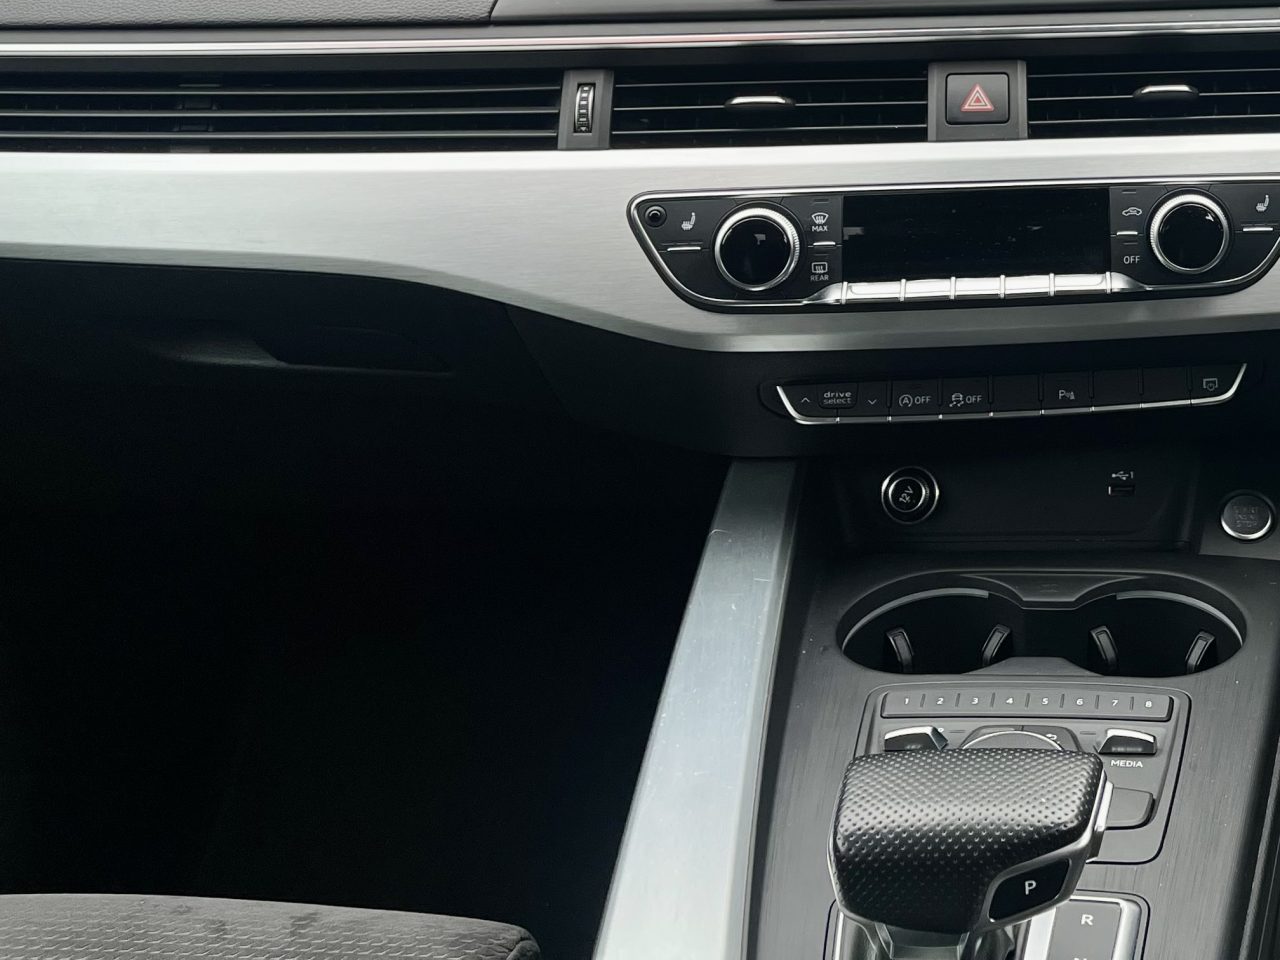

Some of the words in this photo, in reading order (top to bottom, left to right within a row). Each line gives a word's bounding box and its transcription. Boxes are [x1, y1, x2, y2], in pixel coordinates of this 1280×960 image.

[1123, 255, 1141, 264] OFF
[810, 274, 829, 282] REAR
[823, 397, 852, 405] select
[914, 395, 931, 404] OFF
[965, 394, 982, 404] OFF
[899, 485, 914, 503] 12V
[904, 697, 909, 705] 1
[936, 697, 944, 705] 2
[971, 697, 979, 705] 3
[1006, 697, 1014, 705] 4
[1042, 697, 1049, 705] 5
[1111, 699, 1119, 707] 7
[1145, 700, 1152, 708] 8
[1110, 759, 1143, 768] MEDIA
[1024, 880, 1037, 895] P
[1081, 914, 1094, 926] R
